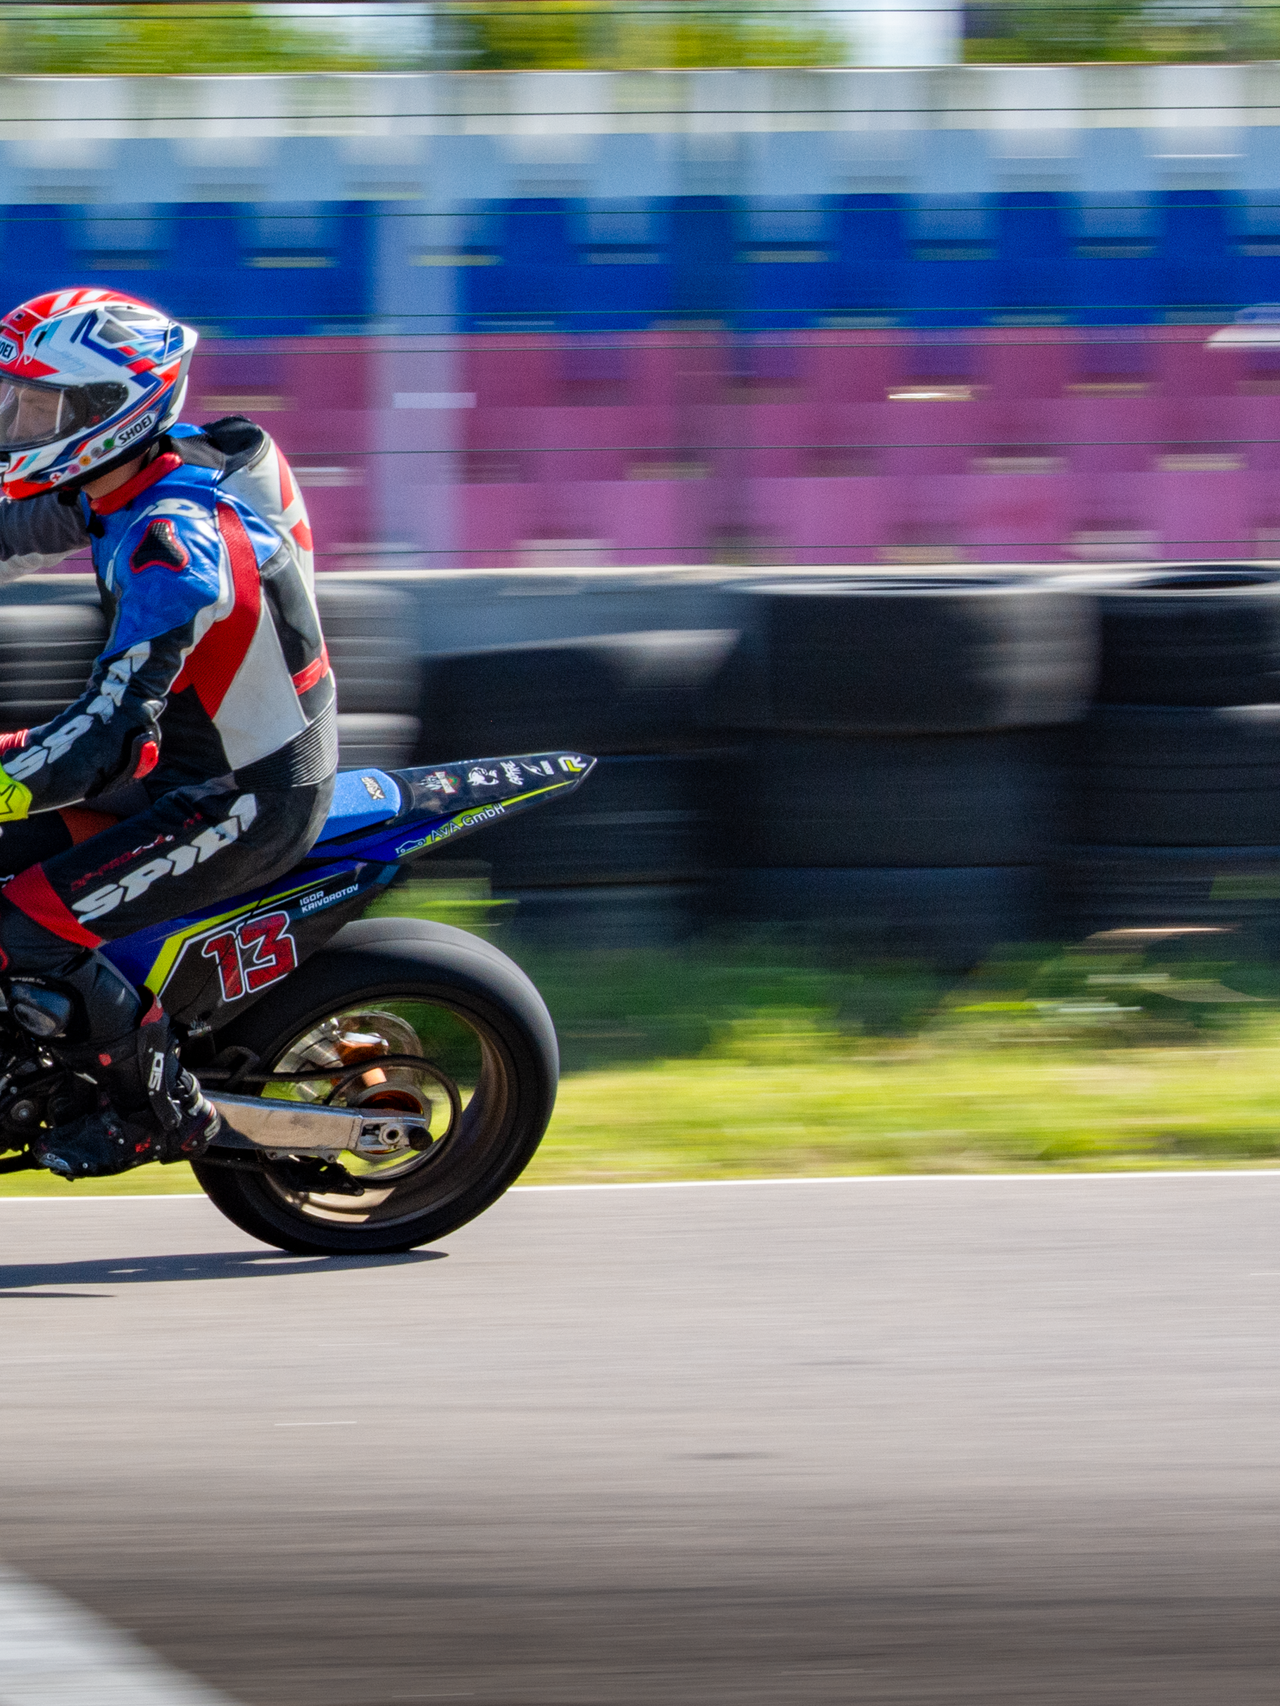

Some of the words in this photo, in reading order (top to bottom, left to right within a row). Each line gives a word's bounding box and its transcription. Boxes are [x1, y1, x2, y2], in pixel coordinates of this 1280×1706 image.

[118, 415, 153, 444] SHOEI
[430, 822, 462, 842] AvA
[462, 802, 506, 827] GmbH
[72, 793, 257, 924] SPIDI
[300, 890, 324, 906] IGOR
[301, 883, 359, 914] KRIVOROTOV
[201, 909, 298, 1002] 13
